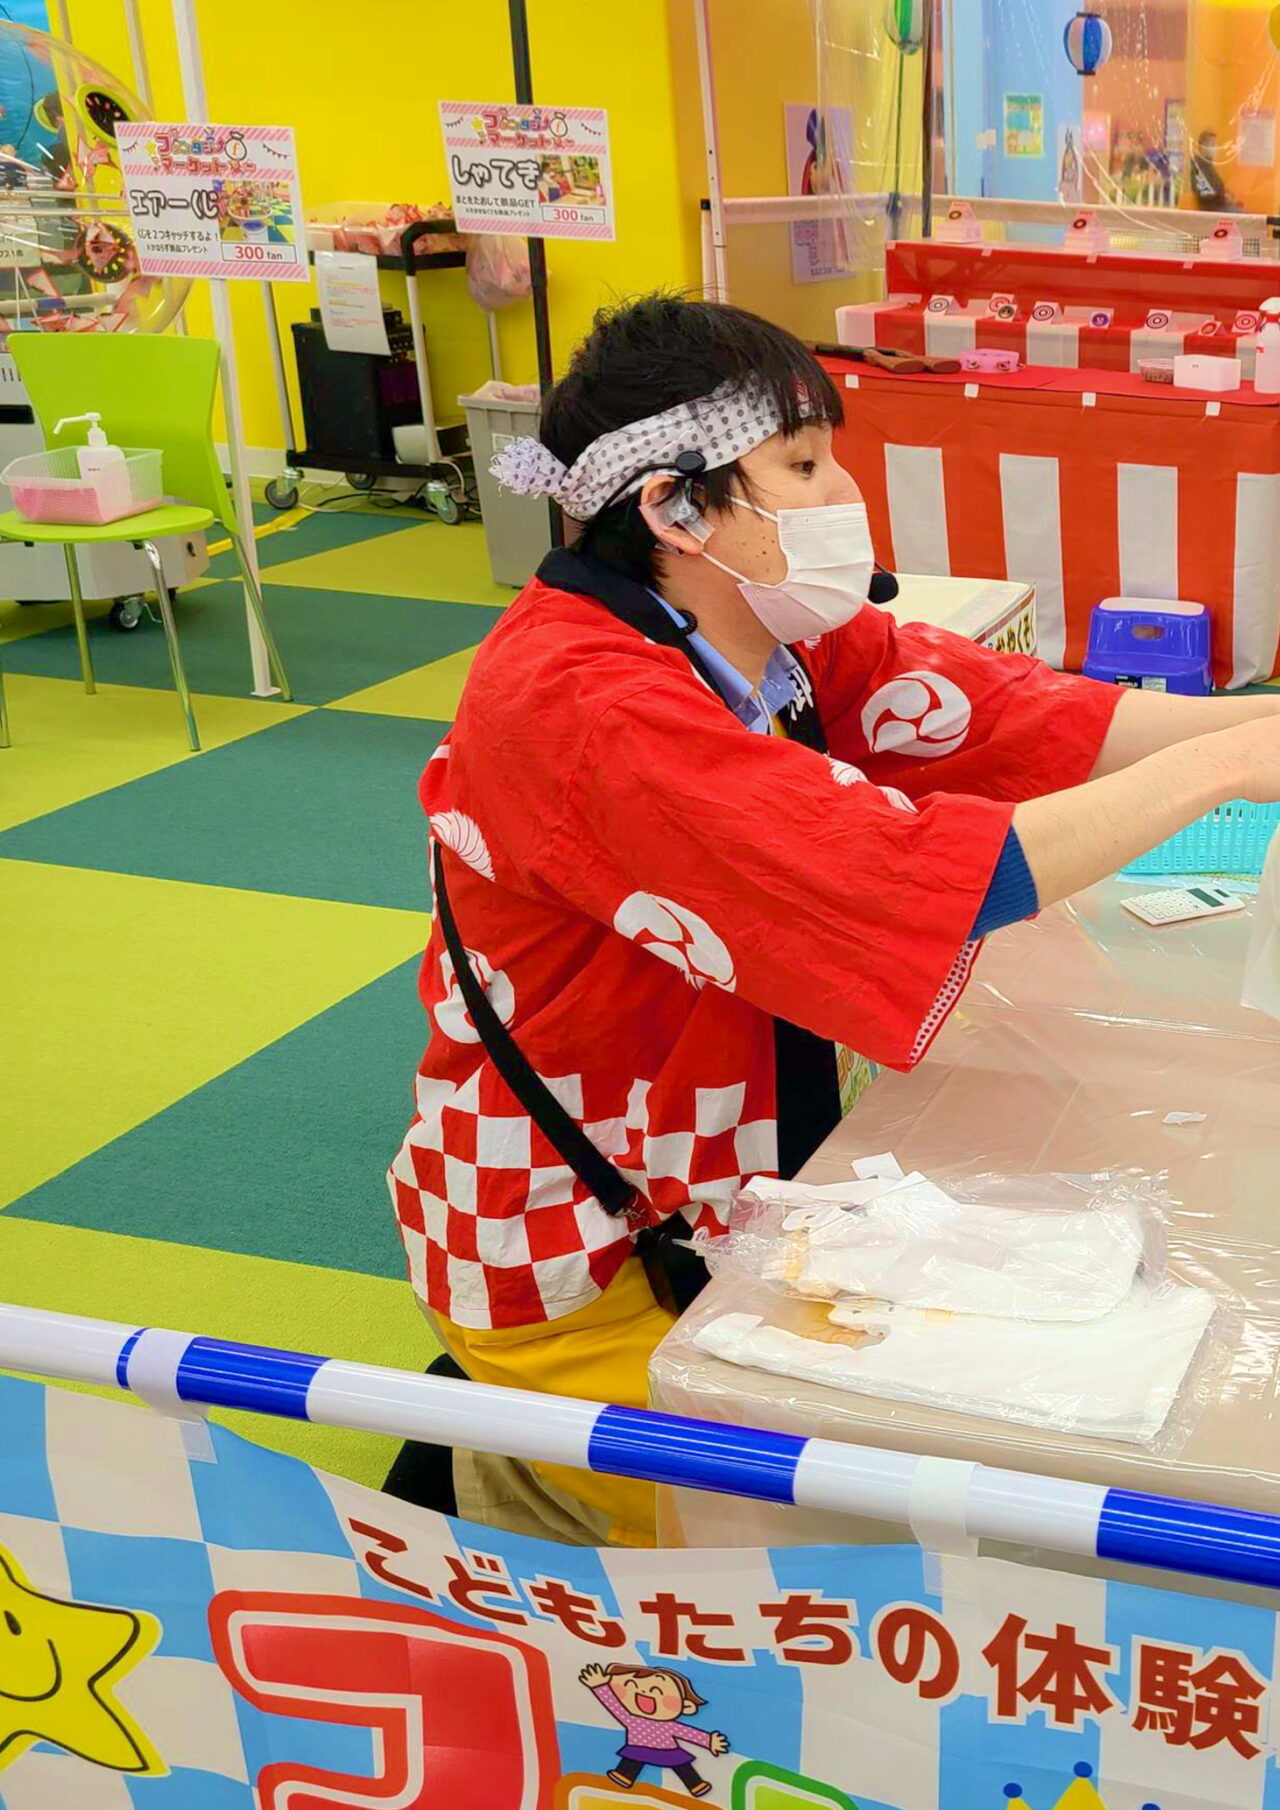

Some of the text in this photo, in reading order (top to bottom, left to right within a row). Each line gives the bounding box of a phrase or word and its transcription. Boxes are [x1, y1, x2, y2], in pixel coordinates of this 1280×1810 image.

[451, 154, 541, 190] しゃてき
[130, 189, 219, 219] エアーくじ
[553, 209, 594, 222] 300 fan
[235, 246, 283, 260] 300 fan
